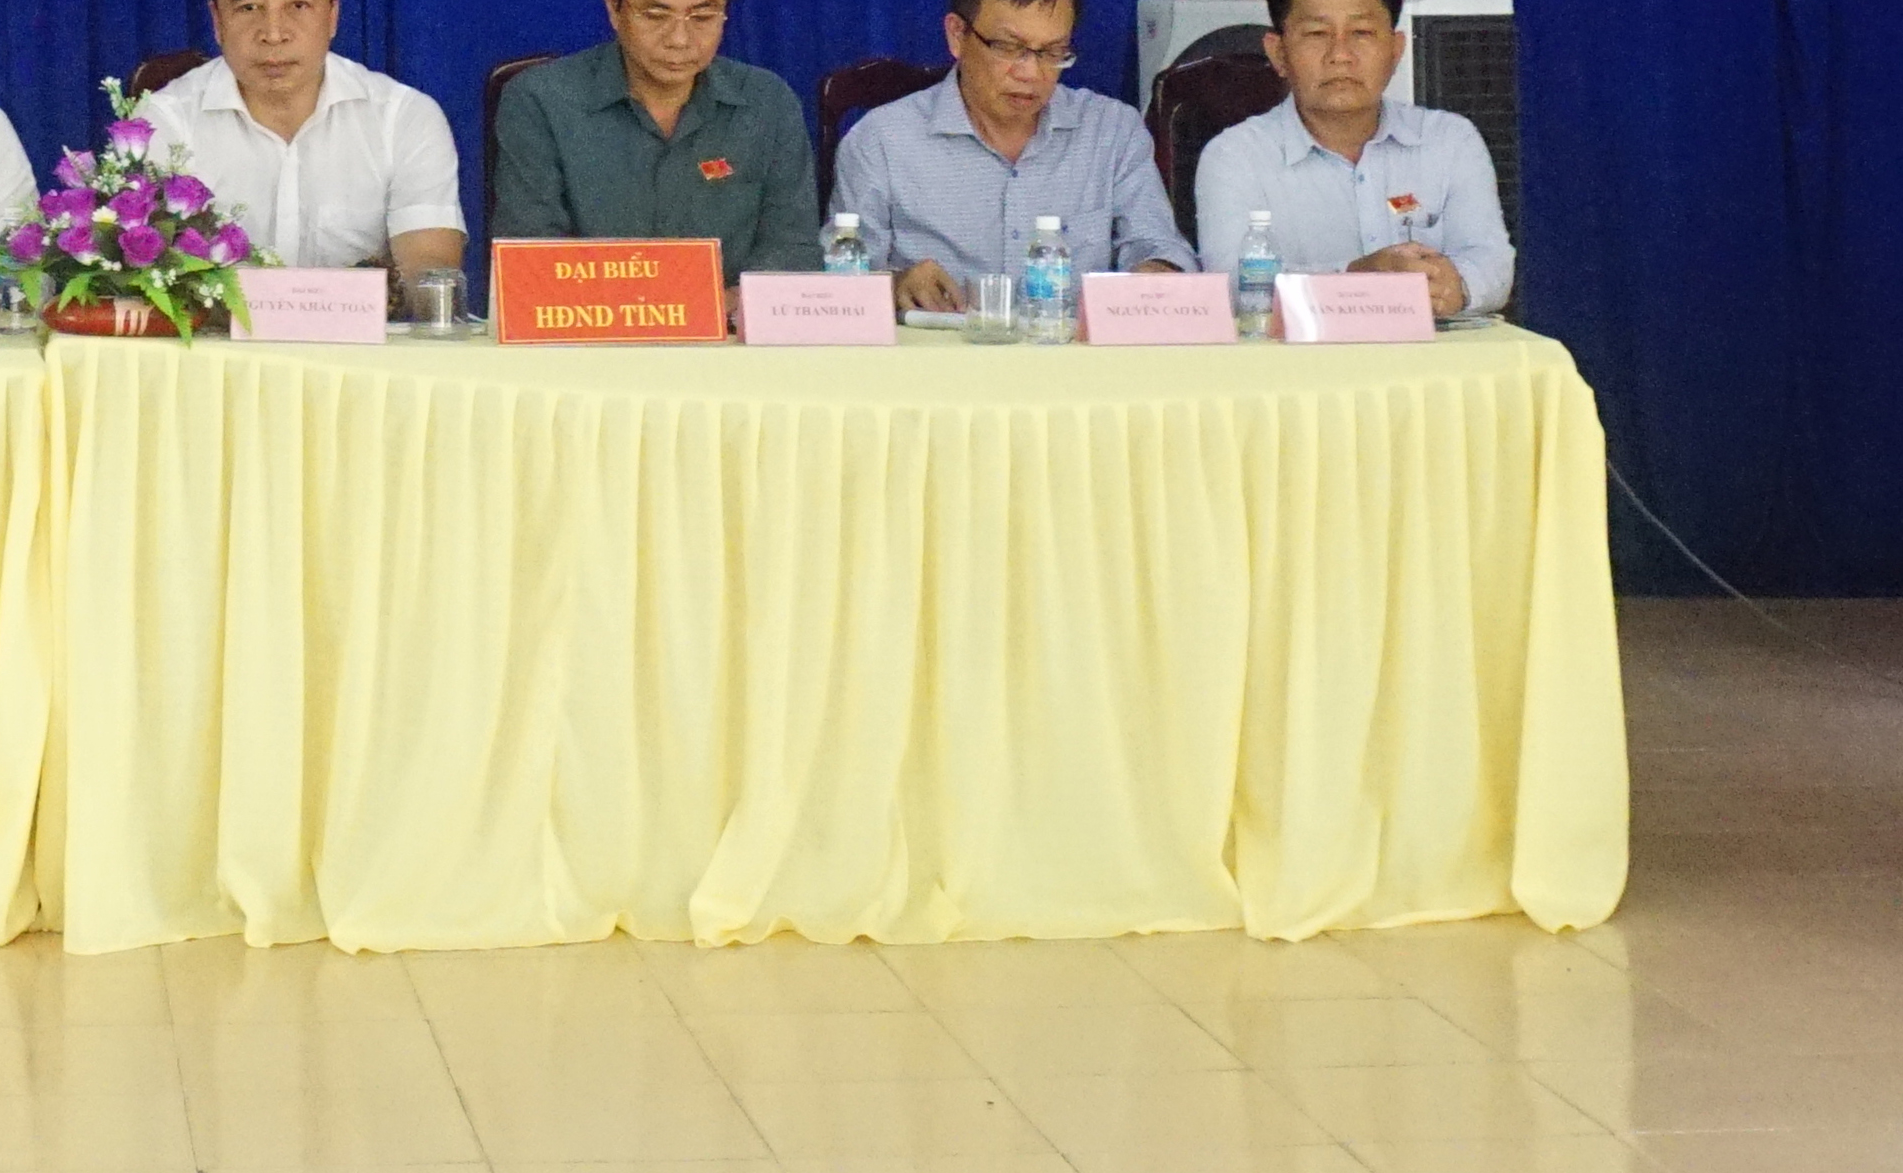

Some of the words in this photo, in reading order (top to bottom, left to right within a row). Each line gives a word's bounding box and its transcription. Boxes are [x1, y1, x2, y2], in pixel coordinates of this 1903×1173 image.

[554, 262, 596, 283] ĐẠI
[603, 252, 660, 279] BIỂU
[535, 304, 614, 328] HĐND
[619, 295, 687, 327] TỈNH
